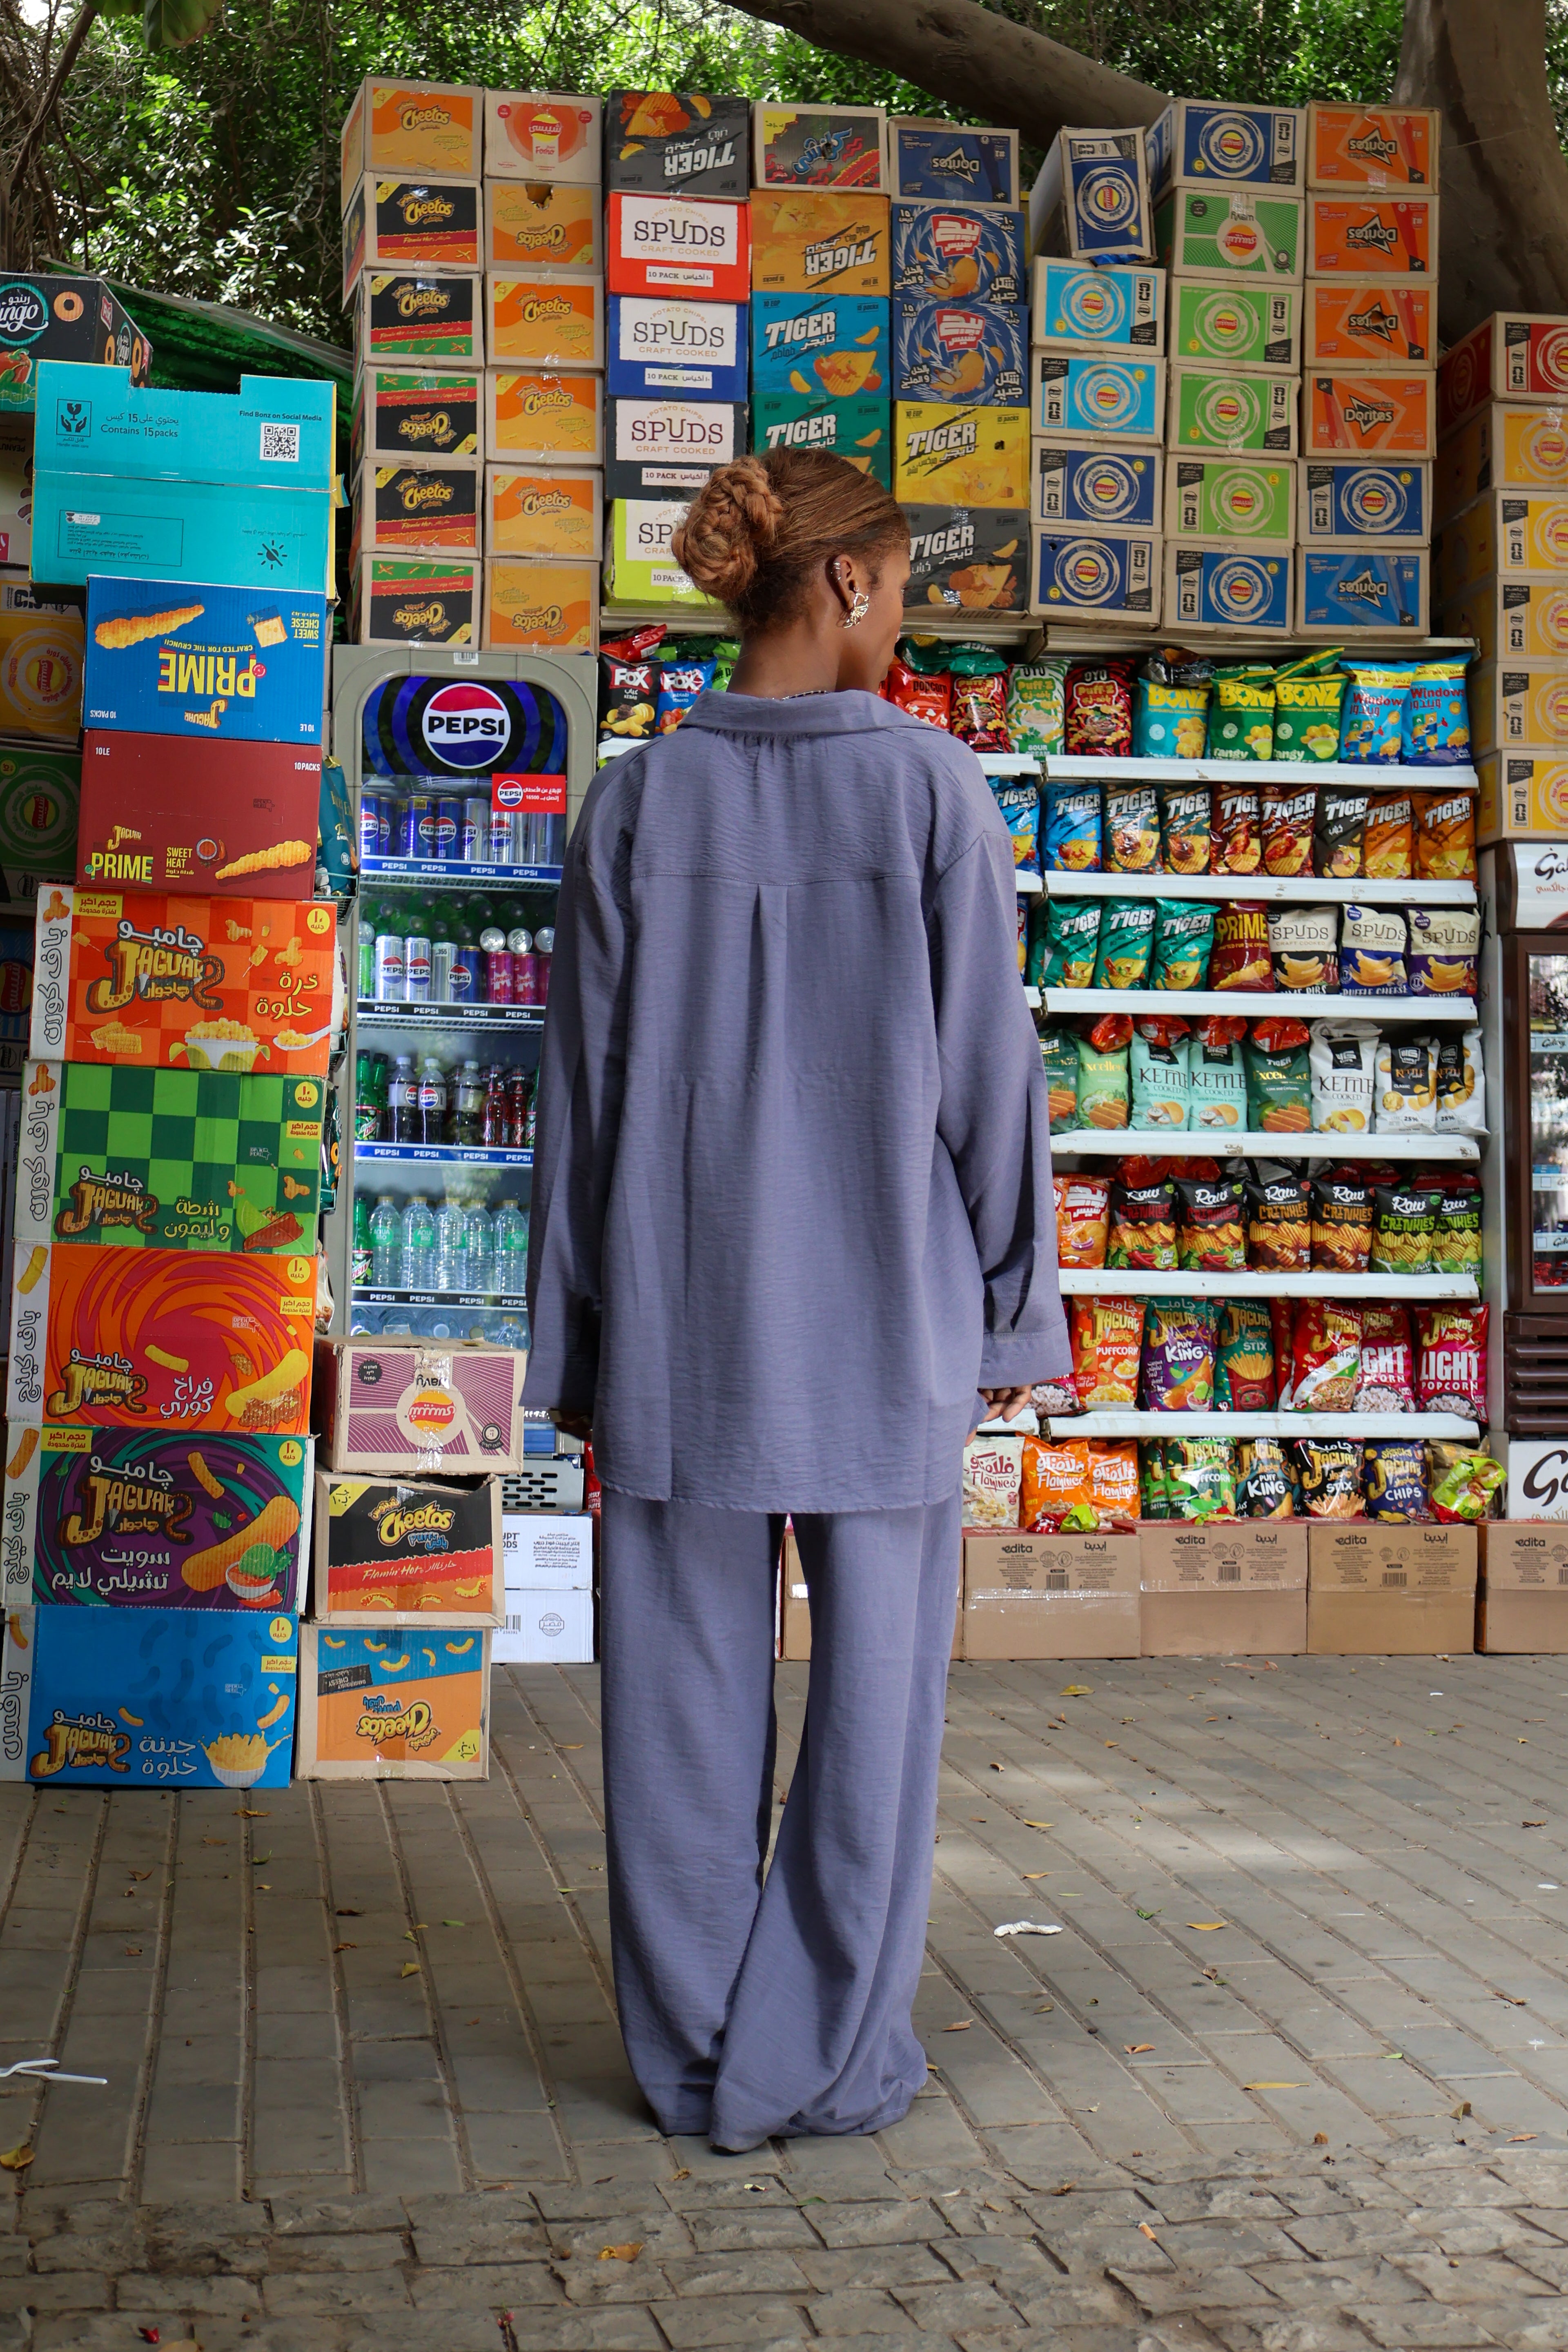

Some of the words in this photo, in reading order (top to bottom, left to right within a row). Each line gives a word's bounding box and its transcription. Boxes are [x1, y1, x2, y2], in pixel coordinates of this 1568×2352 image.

[401, 106, 451, 131] Cheetos
[1348, 139, 1397, 154] Doritos
[664, 142, 735, 177] TIGER
[403, 198, 453, 225] Cheetos
[655, 207, 682, 217] POTATO
[686, 208, 706, 221] CHIPS
[1231, 212, 1254, 221] wavy
[634, 219, 725, 247] SPUDS
[1348, 227, 1397, 242] Doritos
[678, 248, 719, 256] COOKED
[523, 296, 572, 323] Cheetos
[634, 320, 724, 348] SPUDS
[765, 310, 836, 347] TIGER
[639, 346, 673, 355] CRAFT
[676, 348, 717, 357] COOKED
[106, 412, 125, 421] كيس
[128, 413, 138, 423] 15
[139, 414, 153, 423] على
[156, 417, 179, 427] يحتوي
[282, 412, 300, 421] Social
[1345, 409, 1394, 423] Doritos
[101, 424, 140, 435] Contains
[144, 427, 153, 437] 15
[155, 429, 178, 438] packs
[632, 418, 723, 444] SPUDS
[766, 414, 838, 449] TIGER
[907, 422, 977, 457] TIGER
[403, 480, 453, 508] Cheetos
[909, 524, 975, 561] TIGER
[291, 617, 319, 628] CHEESE
[294, 628, 319, 639] SWEET
[158, 648, 256, 697] PRIME
[614, 668, 650, 690] FOX
[913, 680, 948, 694] popcorn
[1276, 683, 1342, 706] BONZ
[1410, 687, 1465, 699] Windows
[1149, 684, 1209, 709] BONZ
[184, 698, 227, 729] JAGUAR
[428, 716, 505, 736] PEPSI
[95, 747, 102, 755] 10
[102, 747, 110, 756] LE
[294, 762, 301, 771] 10
[302, 762, 321, 772] PACKS
[1056, 794, 1100, 816] TIGER
[1262, 792, 1316, 821] TIGER
[167, 847, 192, 859] SWEET
[91, 852, 154, 884] PRIME
[167, 858, 187, 869] HEAT
[382, 862, 407, 871] PEPSI
[100, 899, 117, 908] حجم
[1163, 914, 1211, 937] TIGER
[1216, 913, 1267, 941] PRIME
[1272, 924, 1329, 940] SPUDS
[1422, 929, 1476, 945] SPUDS
[93, 940, 204, 1011] JAGUAR
[279, 972, 318, 996] ذرة
[256, 997, 313, 1020] حلوة
[1154, 1085, 1181, 1094] COOKED
[1191, 1071, 1246, 1090] KETTLE
[1319, 1076, 1374, 1094] KETTLE
[60, 1183, 143, 1233] JAGUAR
[1187, 1204, 1238, 1222] CRINKLES
[1392, 1196, 1427, 1213] Raw
[164, 1219, 214, 1239] ليمون
[1380, 1214, 1434, 1231] CRINKLES
[1096, 1346, 1138, 1356] PUFFCORN
[1165, 1346, 1203, 1363] KING
[1243, 1342, 1267, 1351] STIX
[1420, 1351, 1480, 1381] LIGHT
[52, 1364, 133, 1416] JAGUAR
[174, 1375, 213, 1401] فراخ
[1422, 1381, 1478, 1390] POPCORN
[160, 1394, 214, 1419] كوري
[408, 1404, 456, 1421] شيبسي
[1247, 1480, 1286, 1499] KING
[1326, 1481, 1353, 1493] STIX
[1385, 1488, 1421, 1501] CHIPS
[63, 1477, 177, 1544] JAGUAR
[379, 1501, 455, 1546] Cheetos
[1004, 1544, 1033, 1553] edita
[1338, 1535, 1367, 1545] edita
[101, 1550, 171, 1566] سويت
[52, 1567, 91, 1592] لايم
[97, 1568, 169, 1595] تشيلي
[328, 1677, 348, 1686] CHEESY
[338, 1679, 366, 1688] DANGEROUSLY
[356, 1701, 431, 1746] Cheetos
[32, 1724, 116, 1776] JAGUAR
[138, 1736, 197, 1756] جبنة
[142, 1757, 198, 1779] حلوة
